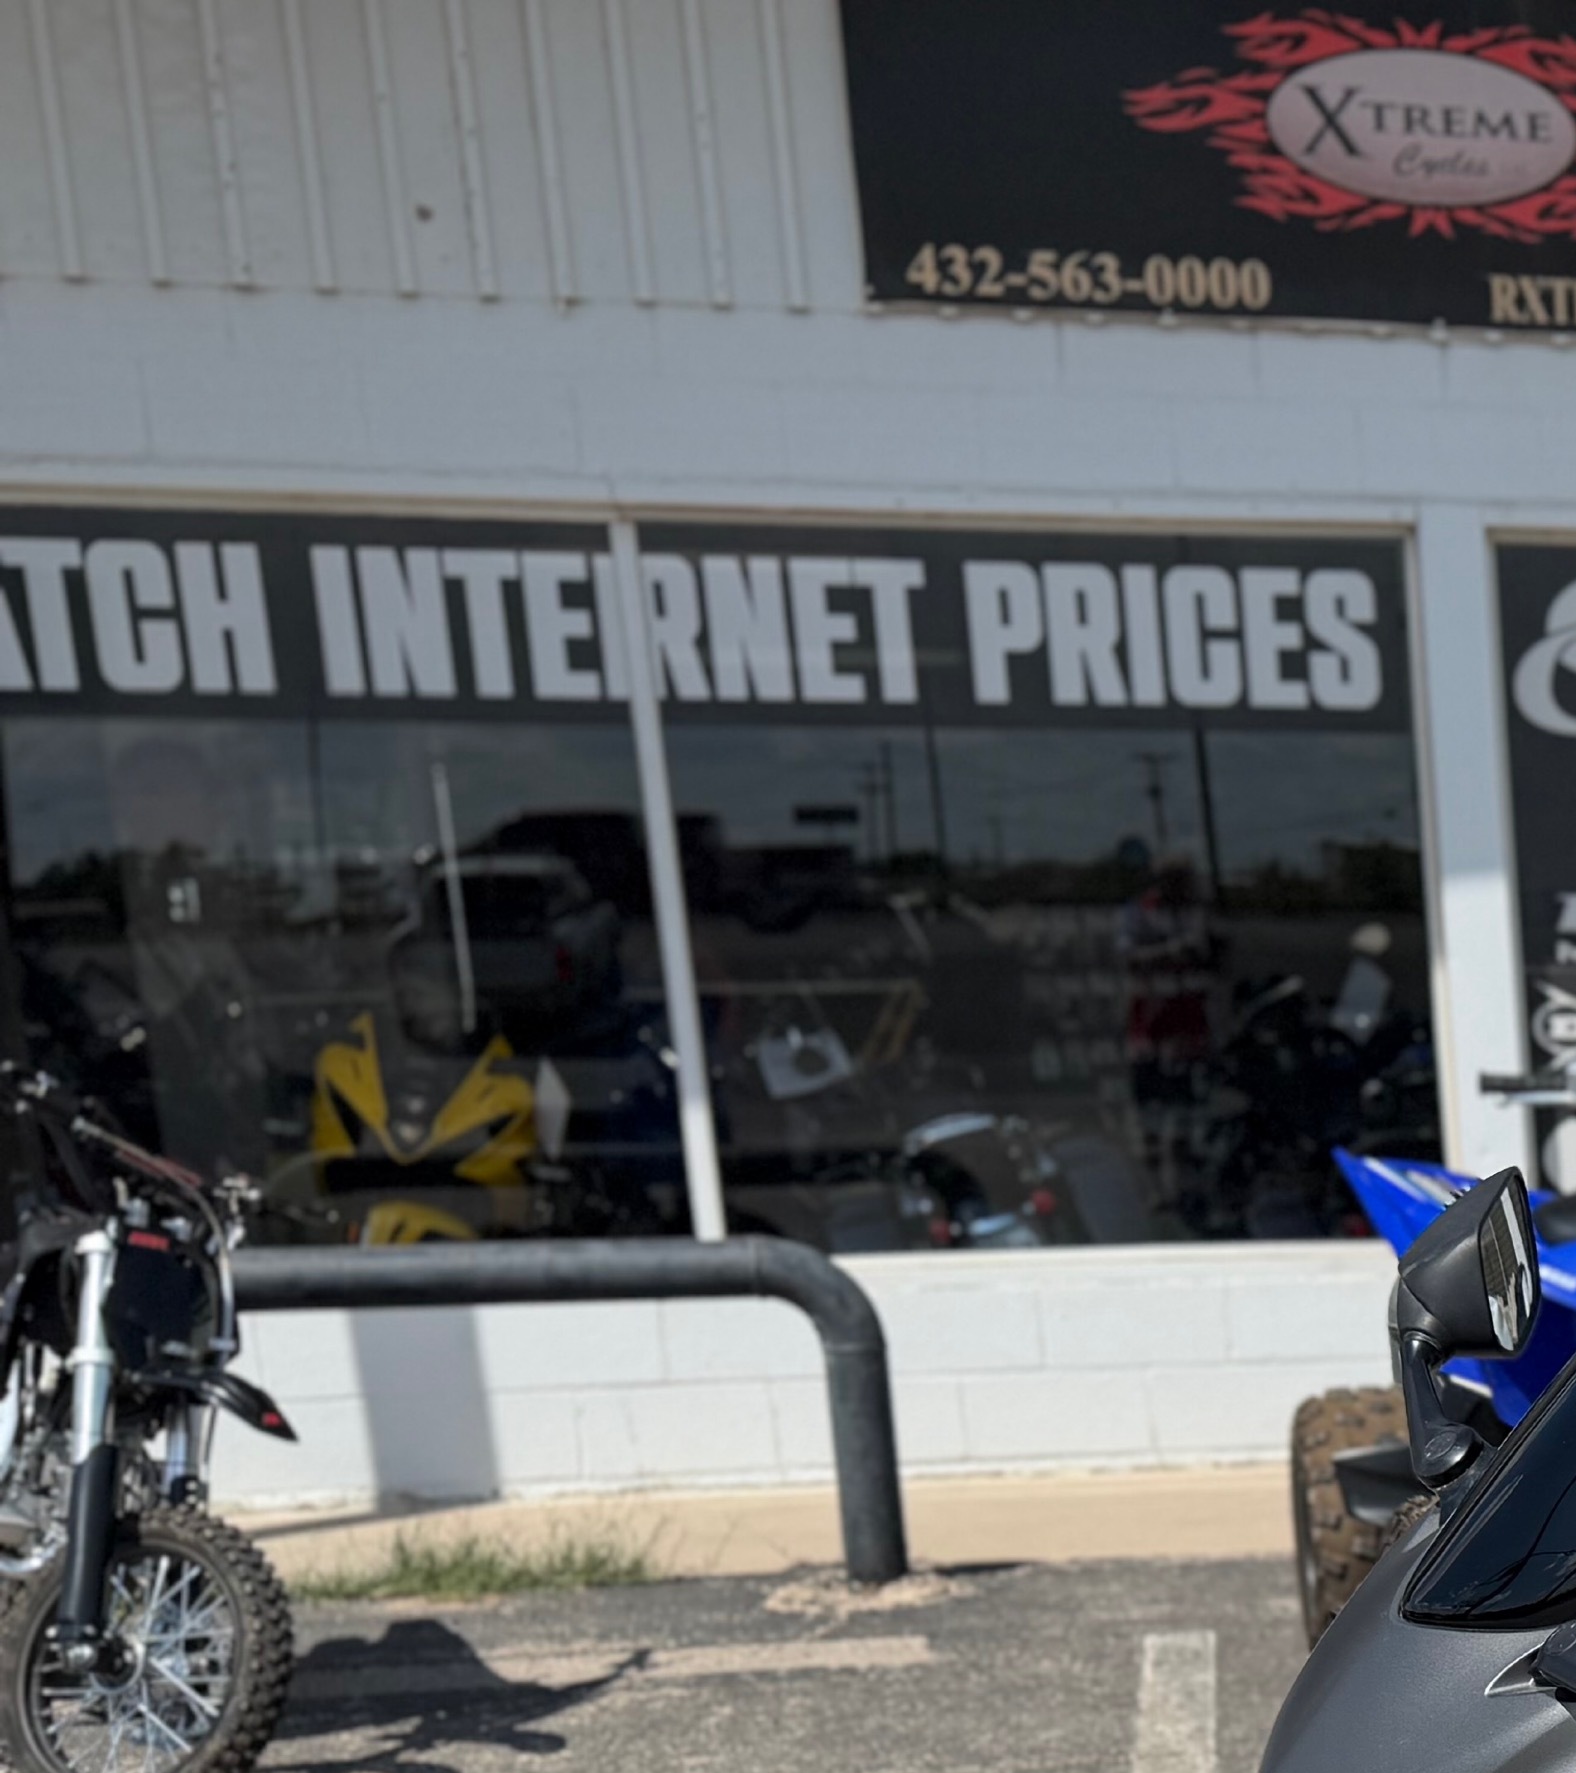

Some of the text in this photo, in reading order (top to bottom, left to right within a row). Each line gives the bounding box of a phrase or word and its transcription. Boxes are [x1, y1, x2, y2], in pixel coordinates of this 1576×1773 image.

[1300, 83, 1553, 157] XTREME
[906, 242, 1272, 310] 432-563-0000
[309, 544, 927, 705] INTERNET
[963, 559, 1386, 712] PRICES
